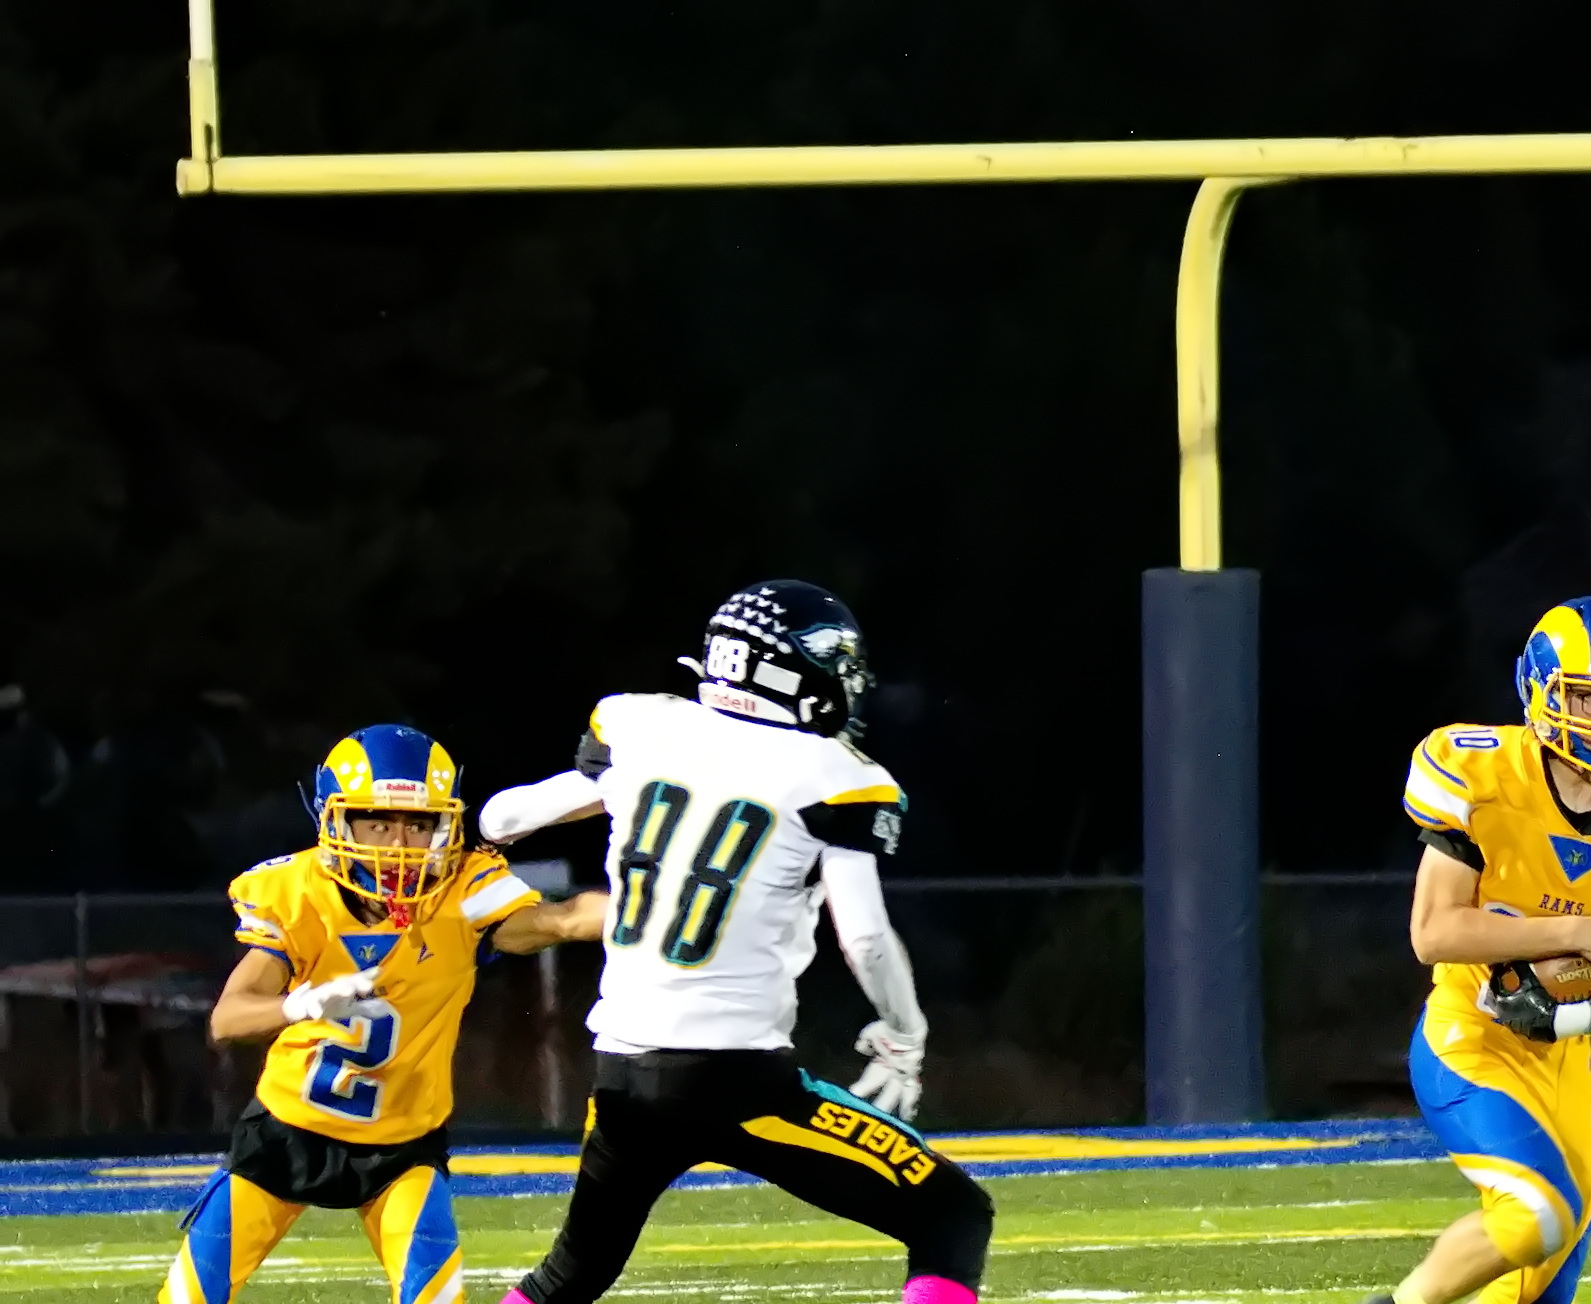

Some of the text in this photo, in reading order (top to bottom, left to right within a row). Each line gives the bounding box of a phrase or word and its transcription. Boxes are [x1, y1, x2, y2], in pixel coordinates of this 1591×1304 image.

[706, 635, 750, 682] 88
[611, 778, 778, 969] 88
[1539, 894, 1586, 916] RAMS
[301, 996, 402, 1125] 2
[809, 1101, 937, 1185] EAGLES
